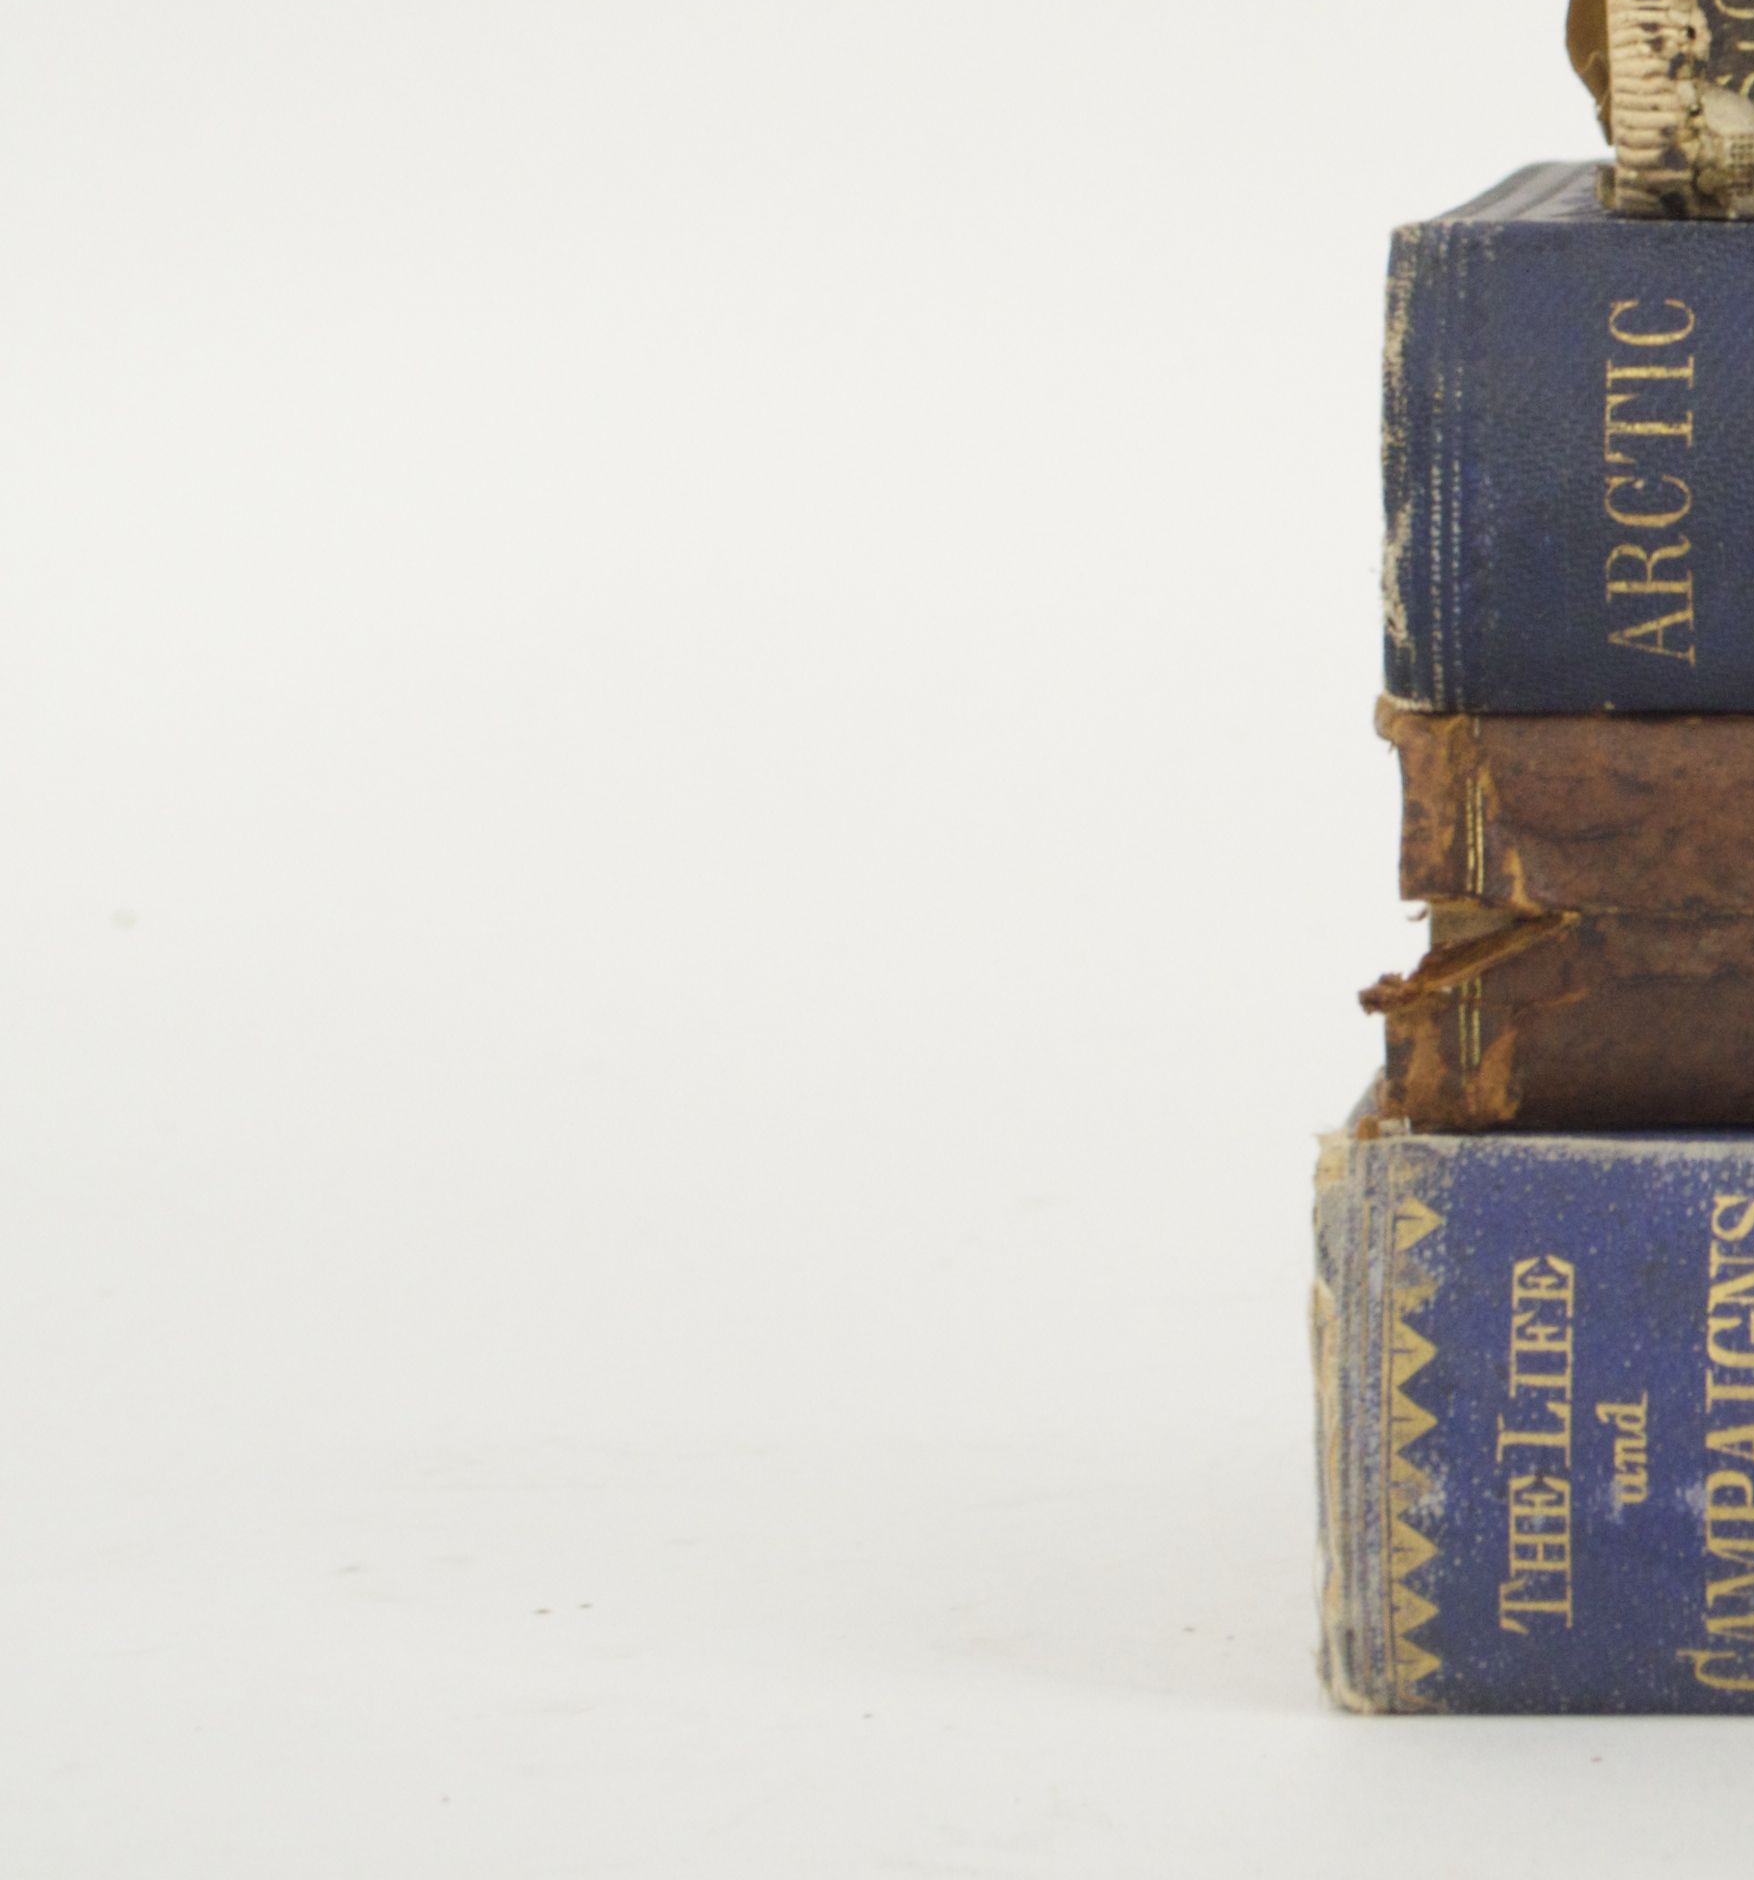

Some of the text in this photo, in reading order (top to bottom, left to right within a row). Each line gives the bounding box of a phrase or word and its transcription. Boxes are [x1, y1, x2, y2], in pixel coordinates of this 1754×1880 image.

[1605, 298, 1696, 668] ARCTIC
[1495, 1252, 1575, 1636] THE LIFE
[1595, 1389, 1649, 1507] and
